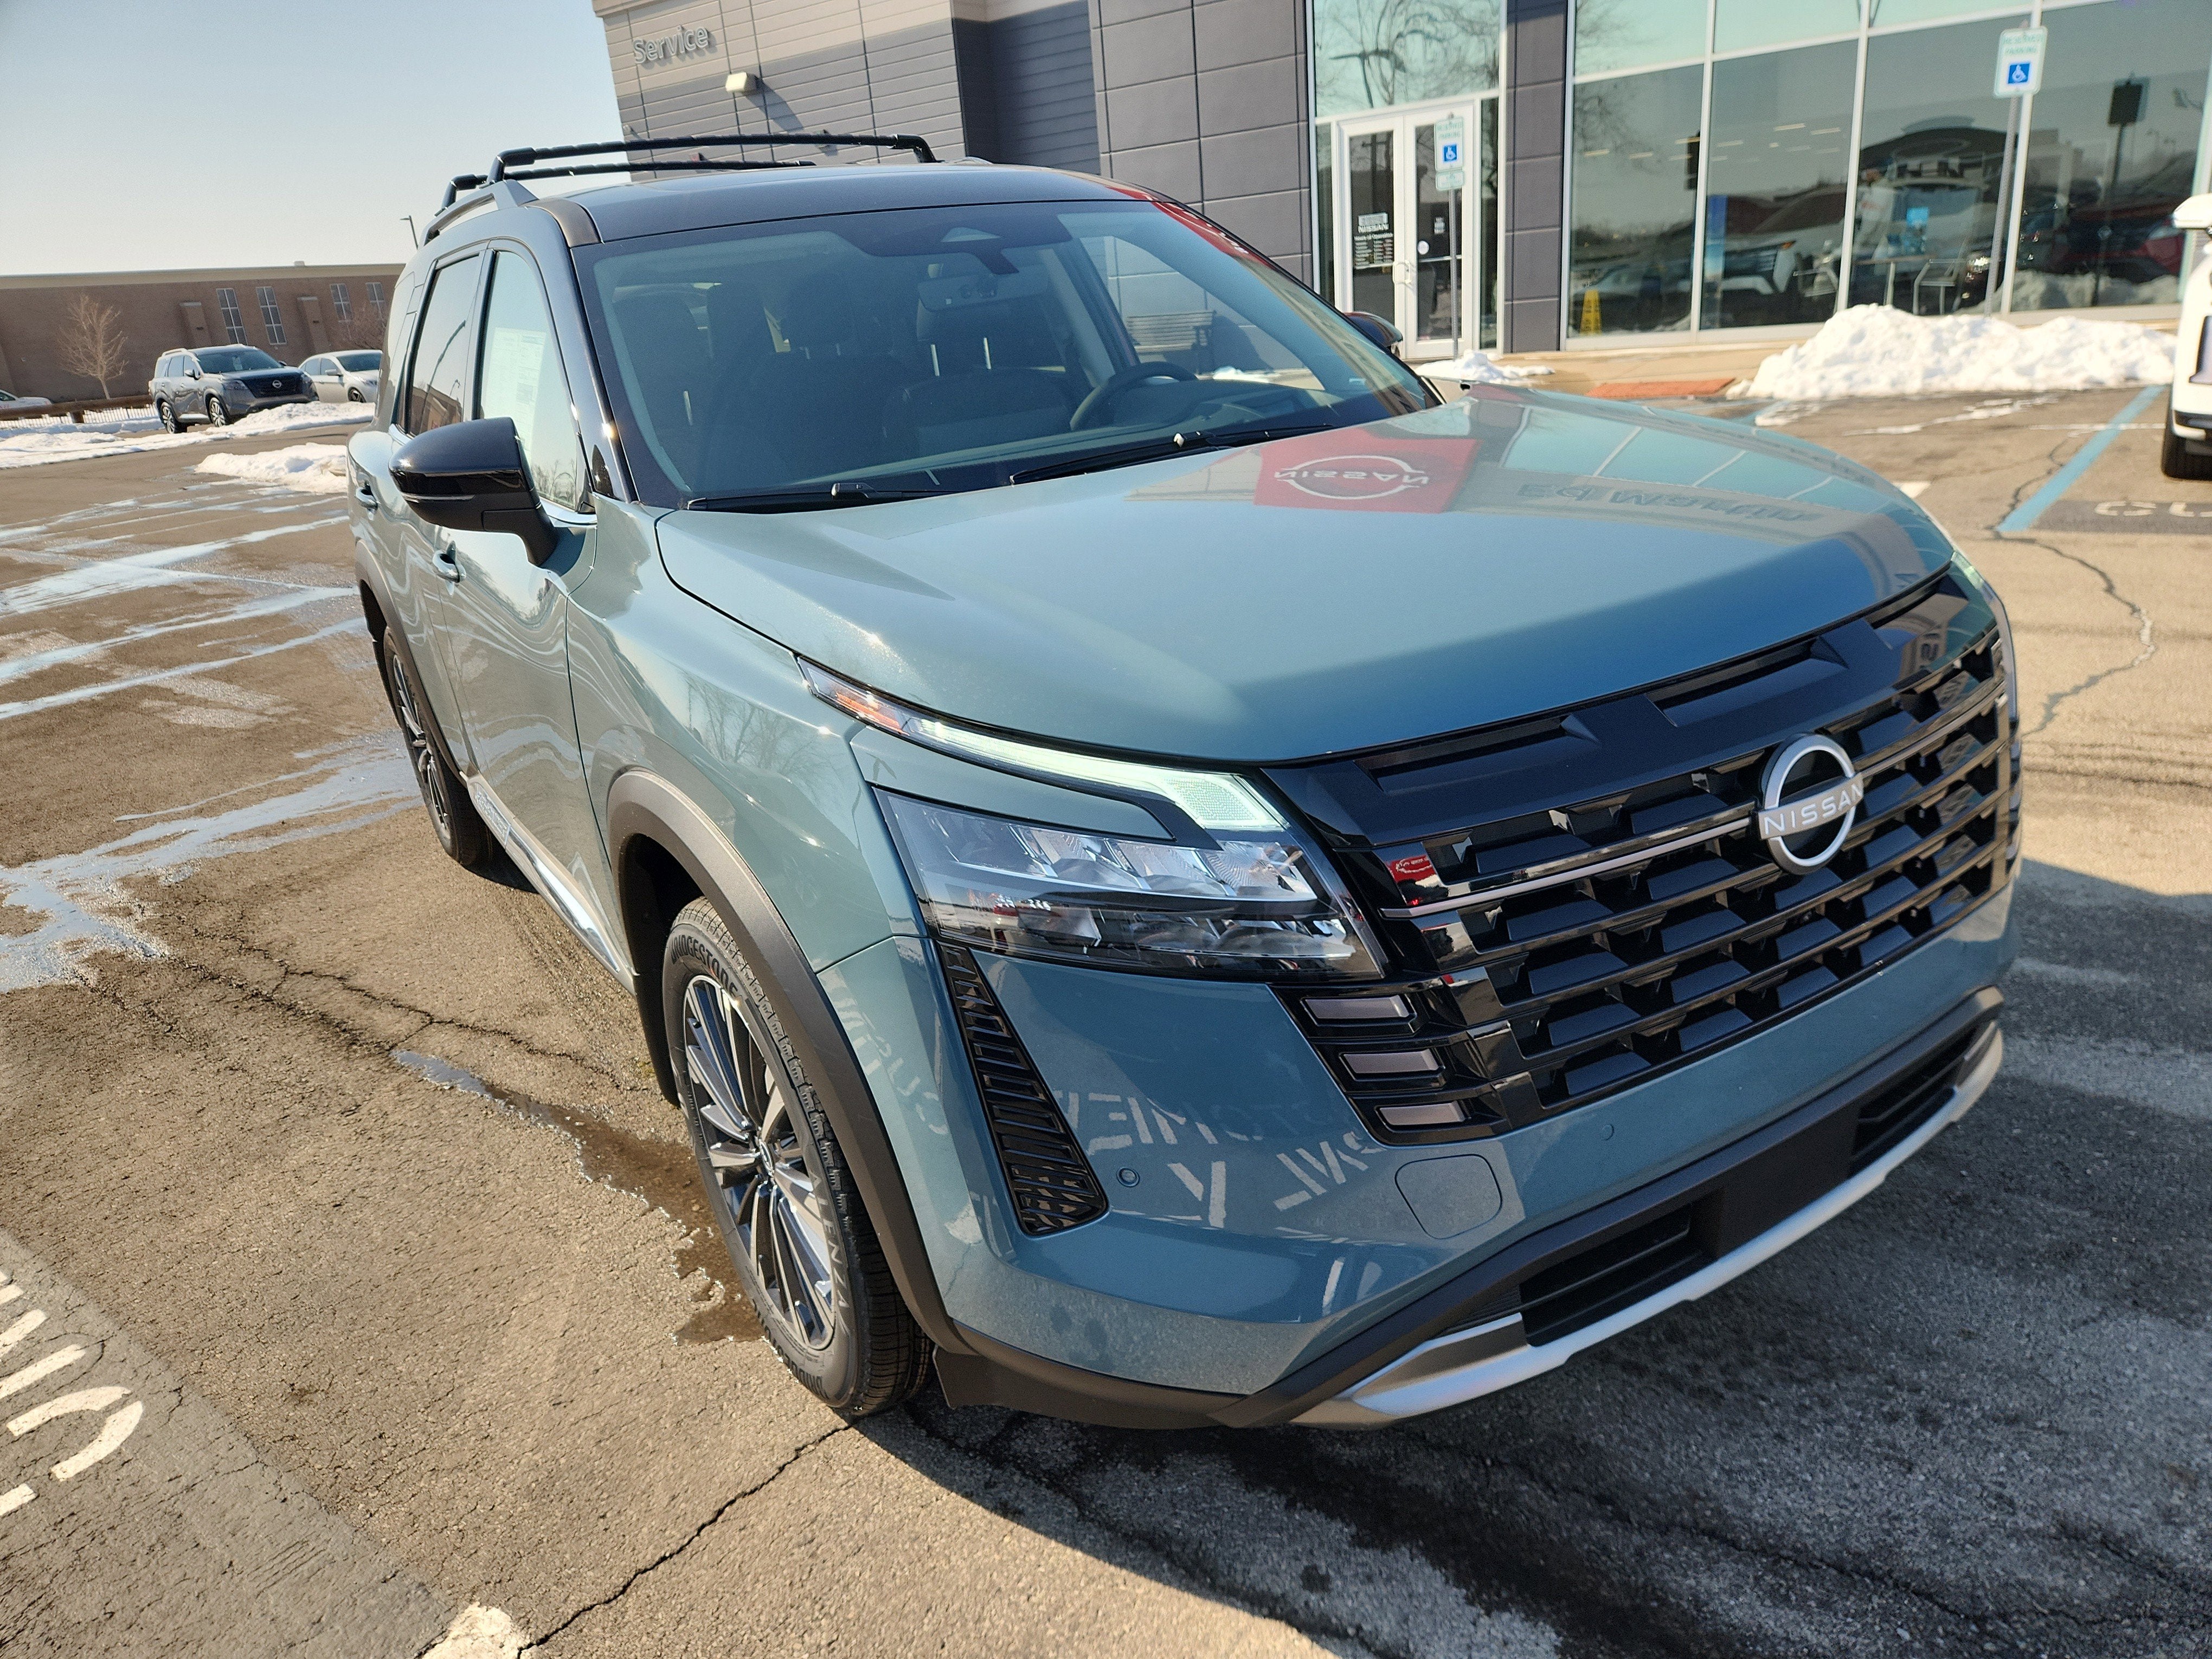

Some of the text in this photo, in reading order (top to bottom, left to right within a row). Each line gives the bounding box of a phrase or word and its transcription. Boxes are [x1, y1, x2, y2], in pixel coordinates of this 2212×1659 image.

[632, 25, 709, 65] Service
[1764, 783, 1863, 835] NISSAN
[809, 1169, 851, 1309] ALENZA
